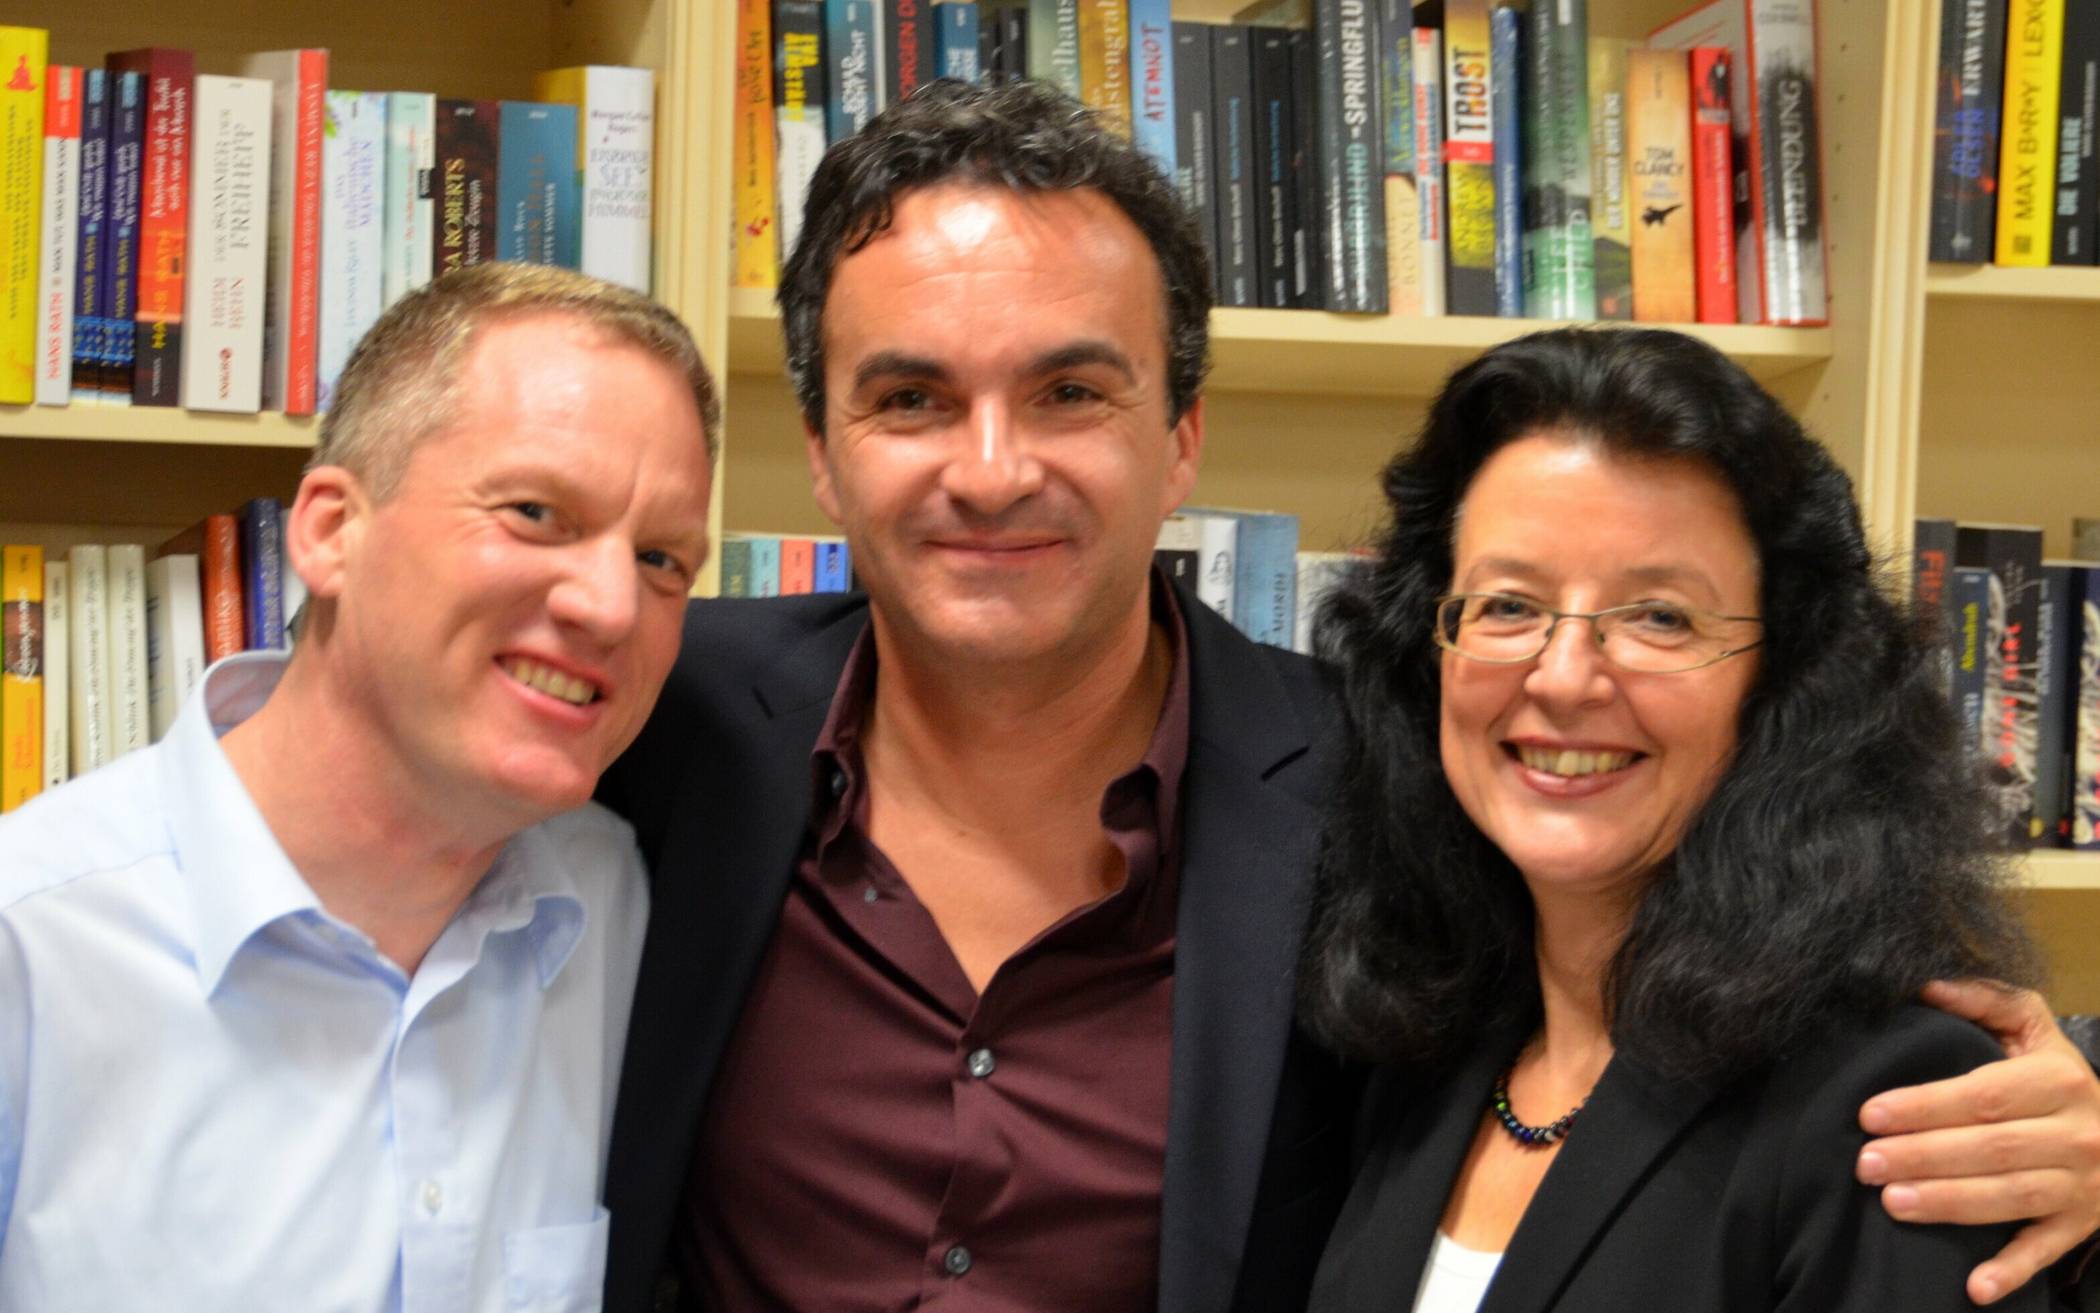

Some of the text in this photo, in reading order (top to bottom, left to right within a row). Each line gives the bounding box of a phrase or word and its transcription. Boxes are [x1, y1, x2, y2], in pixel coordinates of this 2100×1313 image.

[851, 29, 867, 73] NICHT
[898, 0, 917, 95] ORGEN D
[1052, 0, 1077, 92] elhaus
[1096, 0, 1125, 110] stengra
[1140, 22, 1166, 122] ATEMNOT
[1452, 46, 1488, 135] TROST
[211, 142, 230, 232] SOMMER
[443, 158, 465, 247] ROBERTS
[464, 179, 482, 227] Zeugin
[1634, 161, 1684, 178] CLANCY
[2013, 165, 2036, 220] MAX
[82, 235, 97, 315] HANS RATH
[115, 240, 130, 317] HANS RATH
[151, 231, 170, 349] HANS RATH
[1549, 225, 1570, 280] LEE
[1568, 208, 1589, 291] CHILD
[47, 293, 63, 379] HANS RATH
